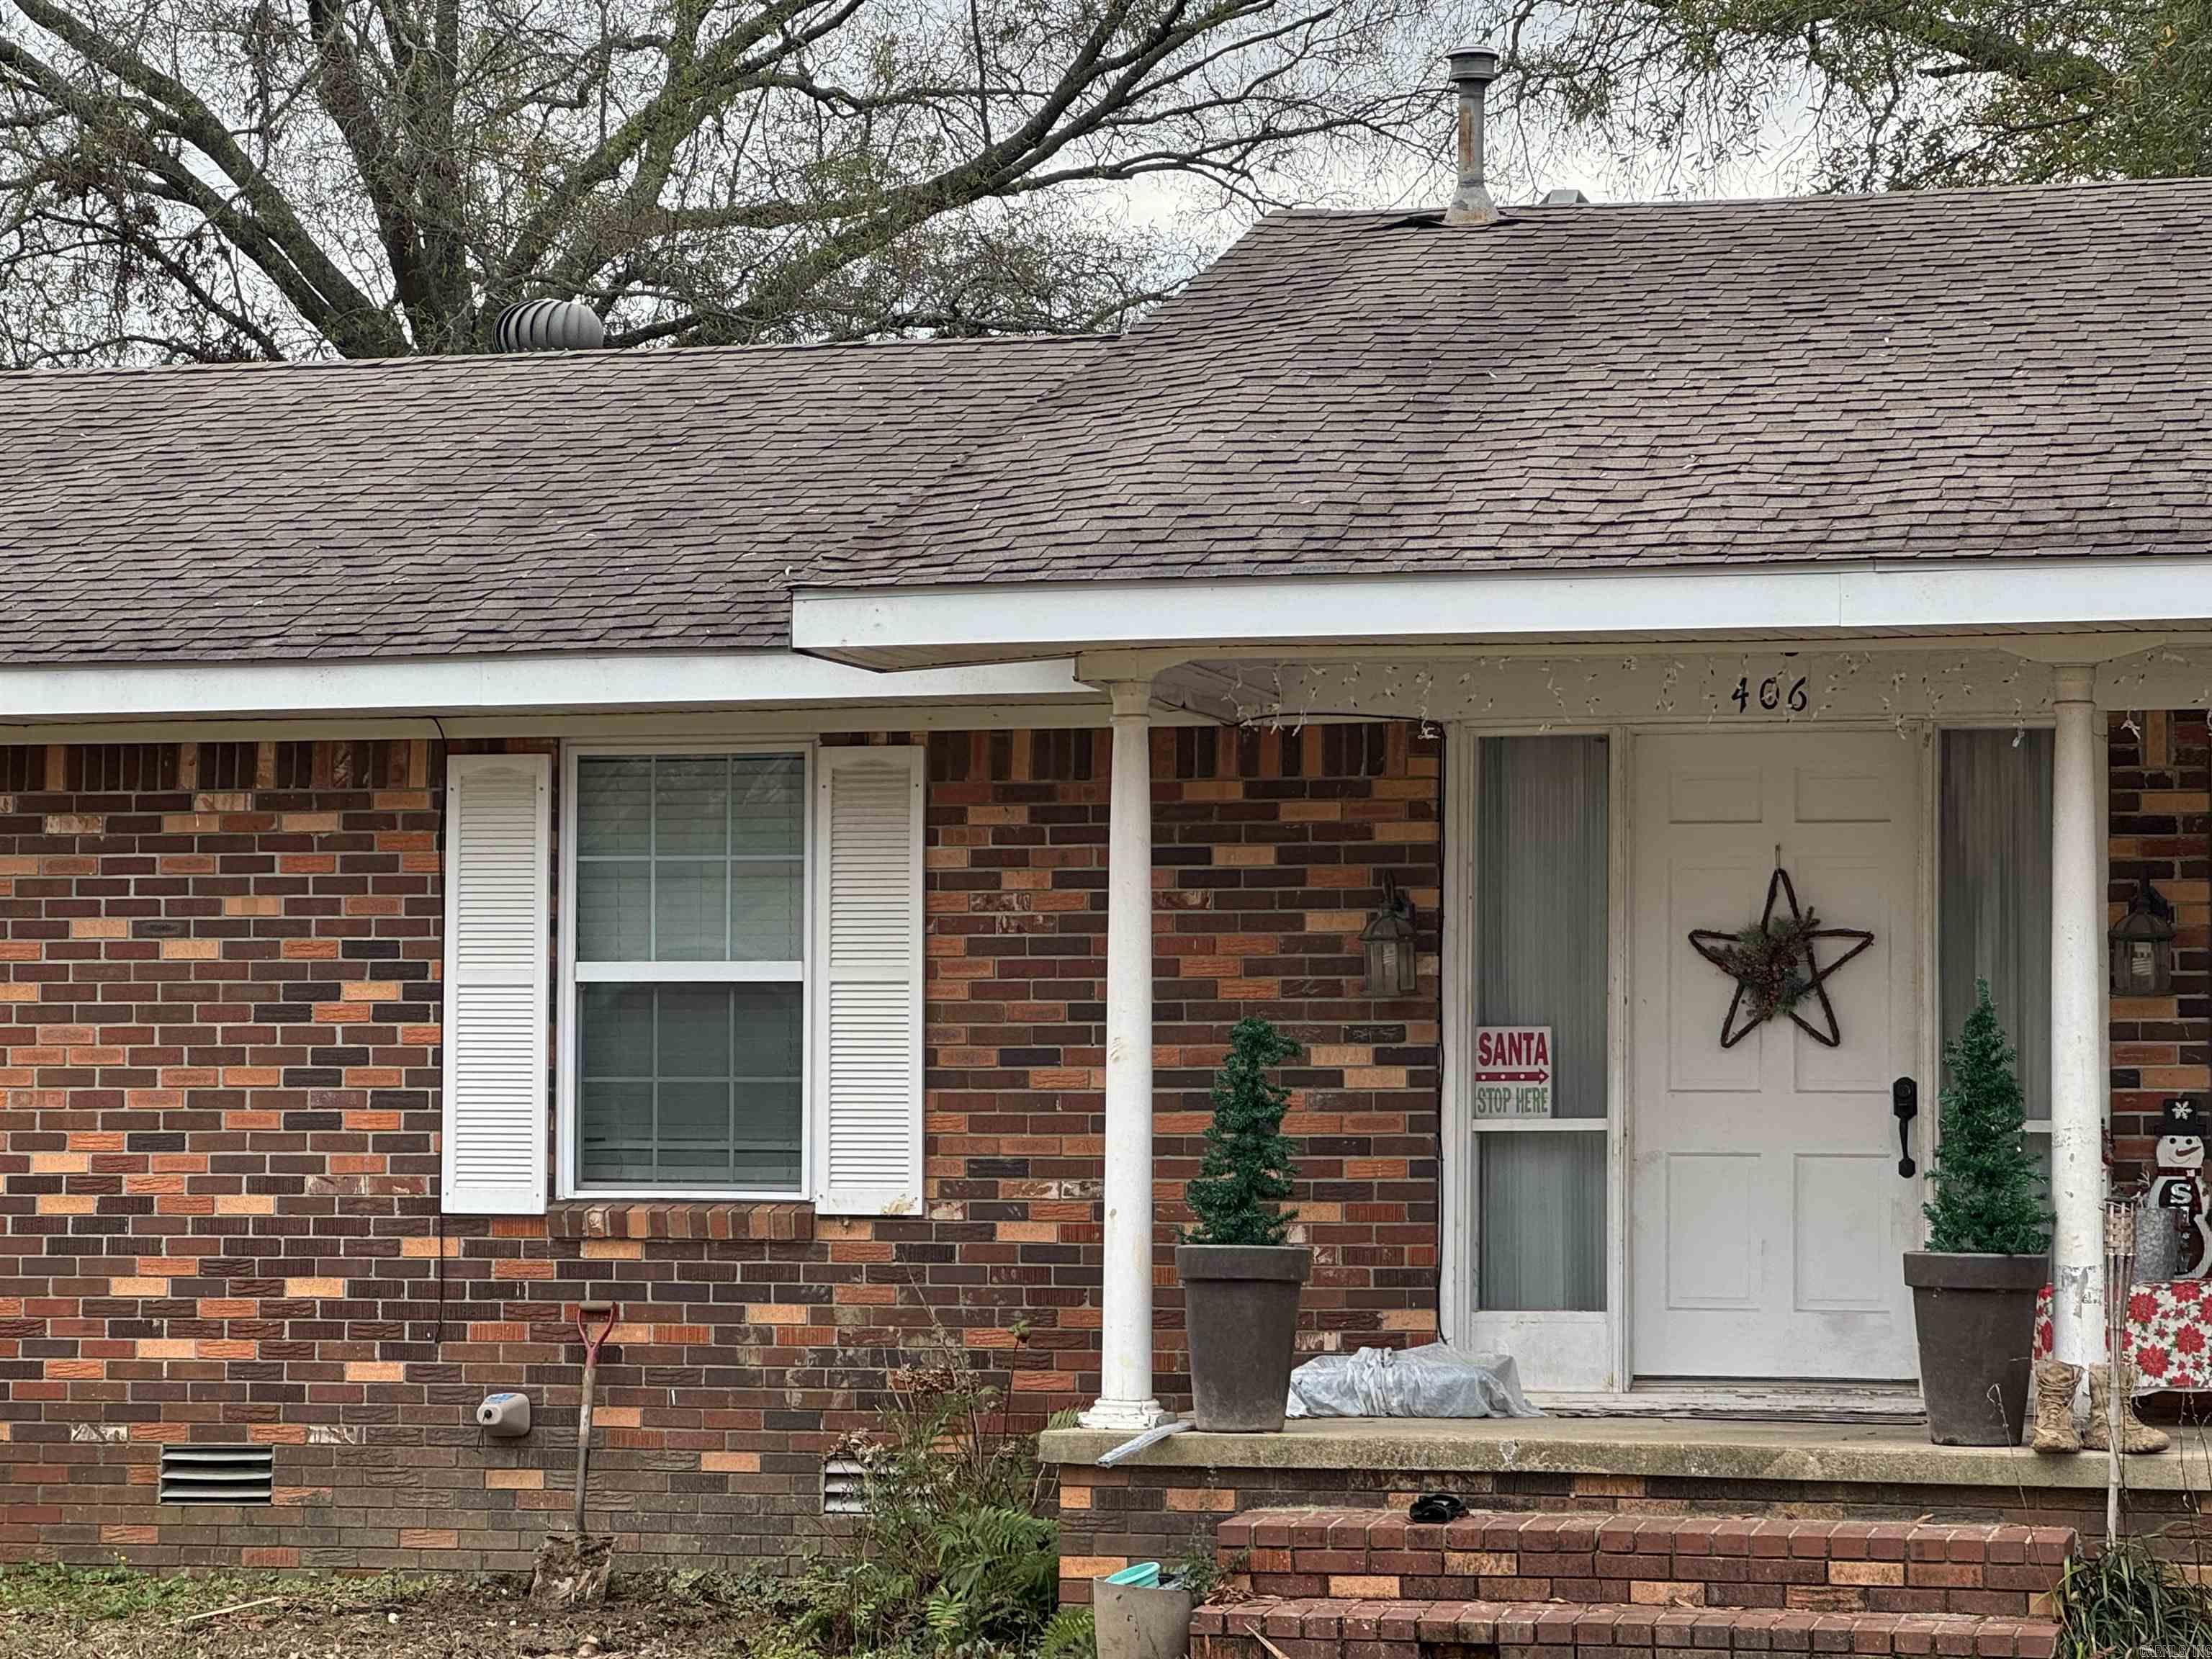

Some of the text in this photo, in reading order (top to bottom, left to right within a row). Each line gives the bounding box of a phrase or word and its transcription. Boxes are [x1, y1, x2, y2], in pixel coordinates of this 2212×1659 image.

[1731, 677, 1807, 714] 406
[1478, 1032, 1549, 1066] SANTA
[1478, 1087, 1548, 1114] STOP HERE
